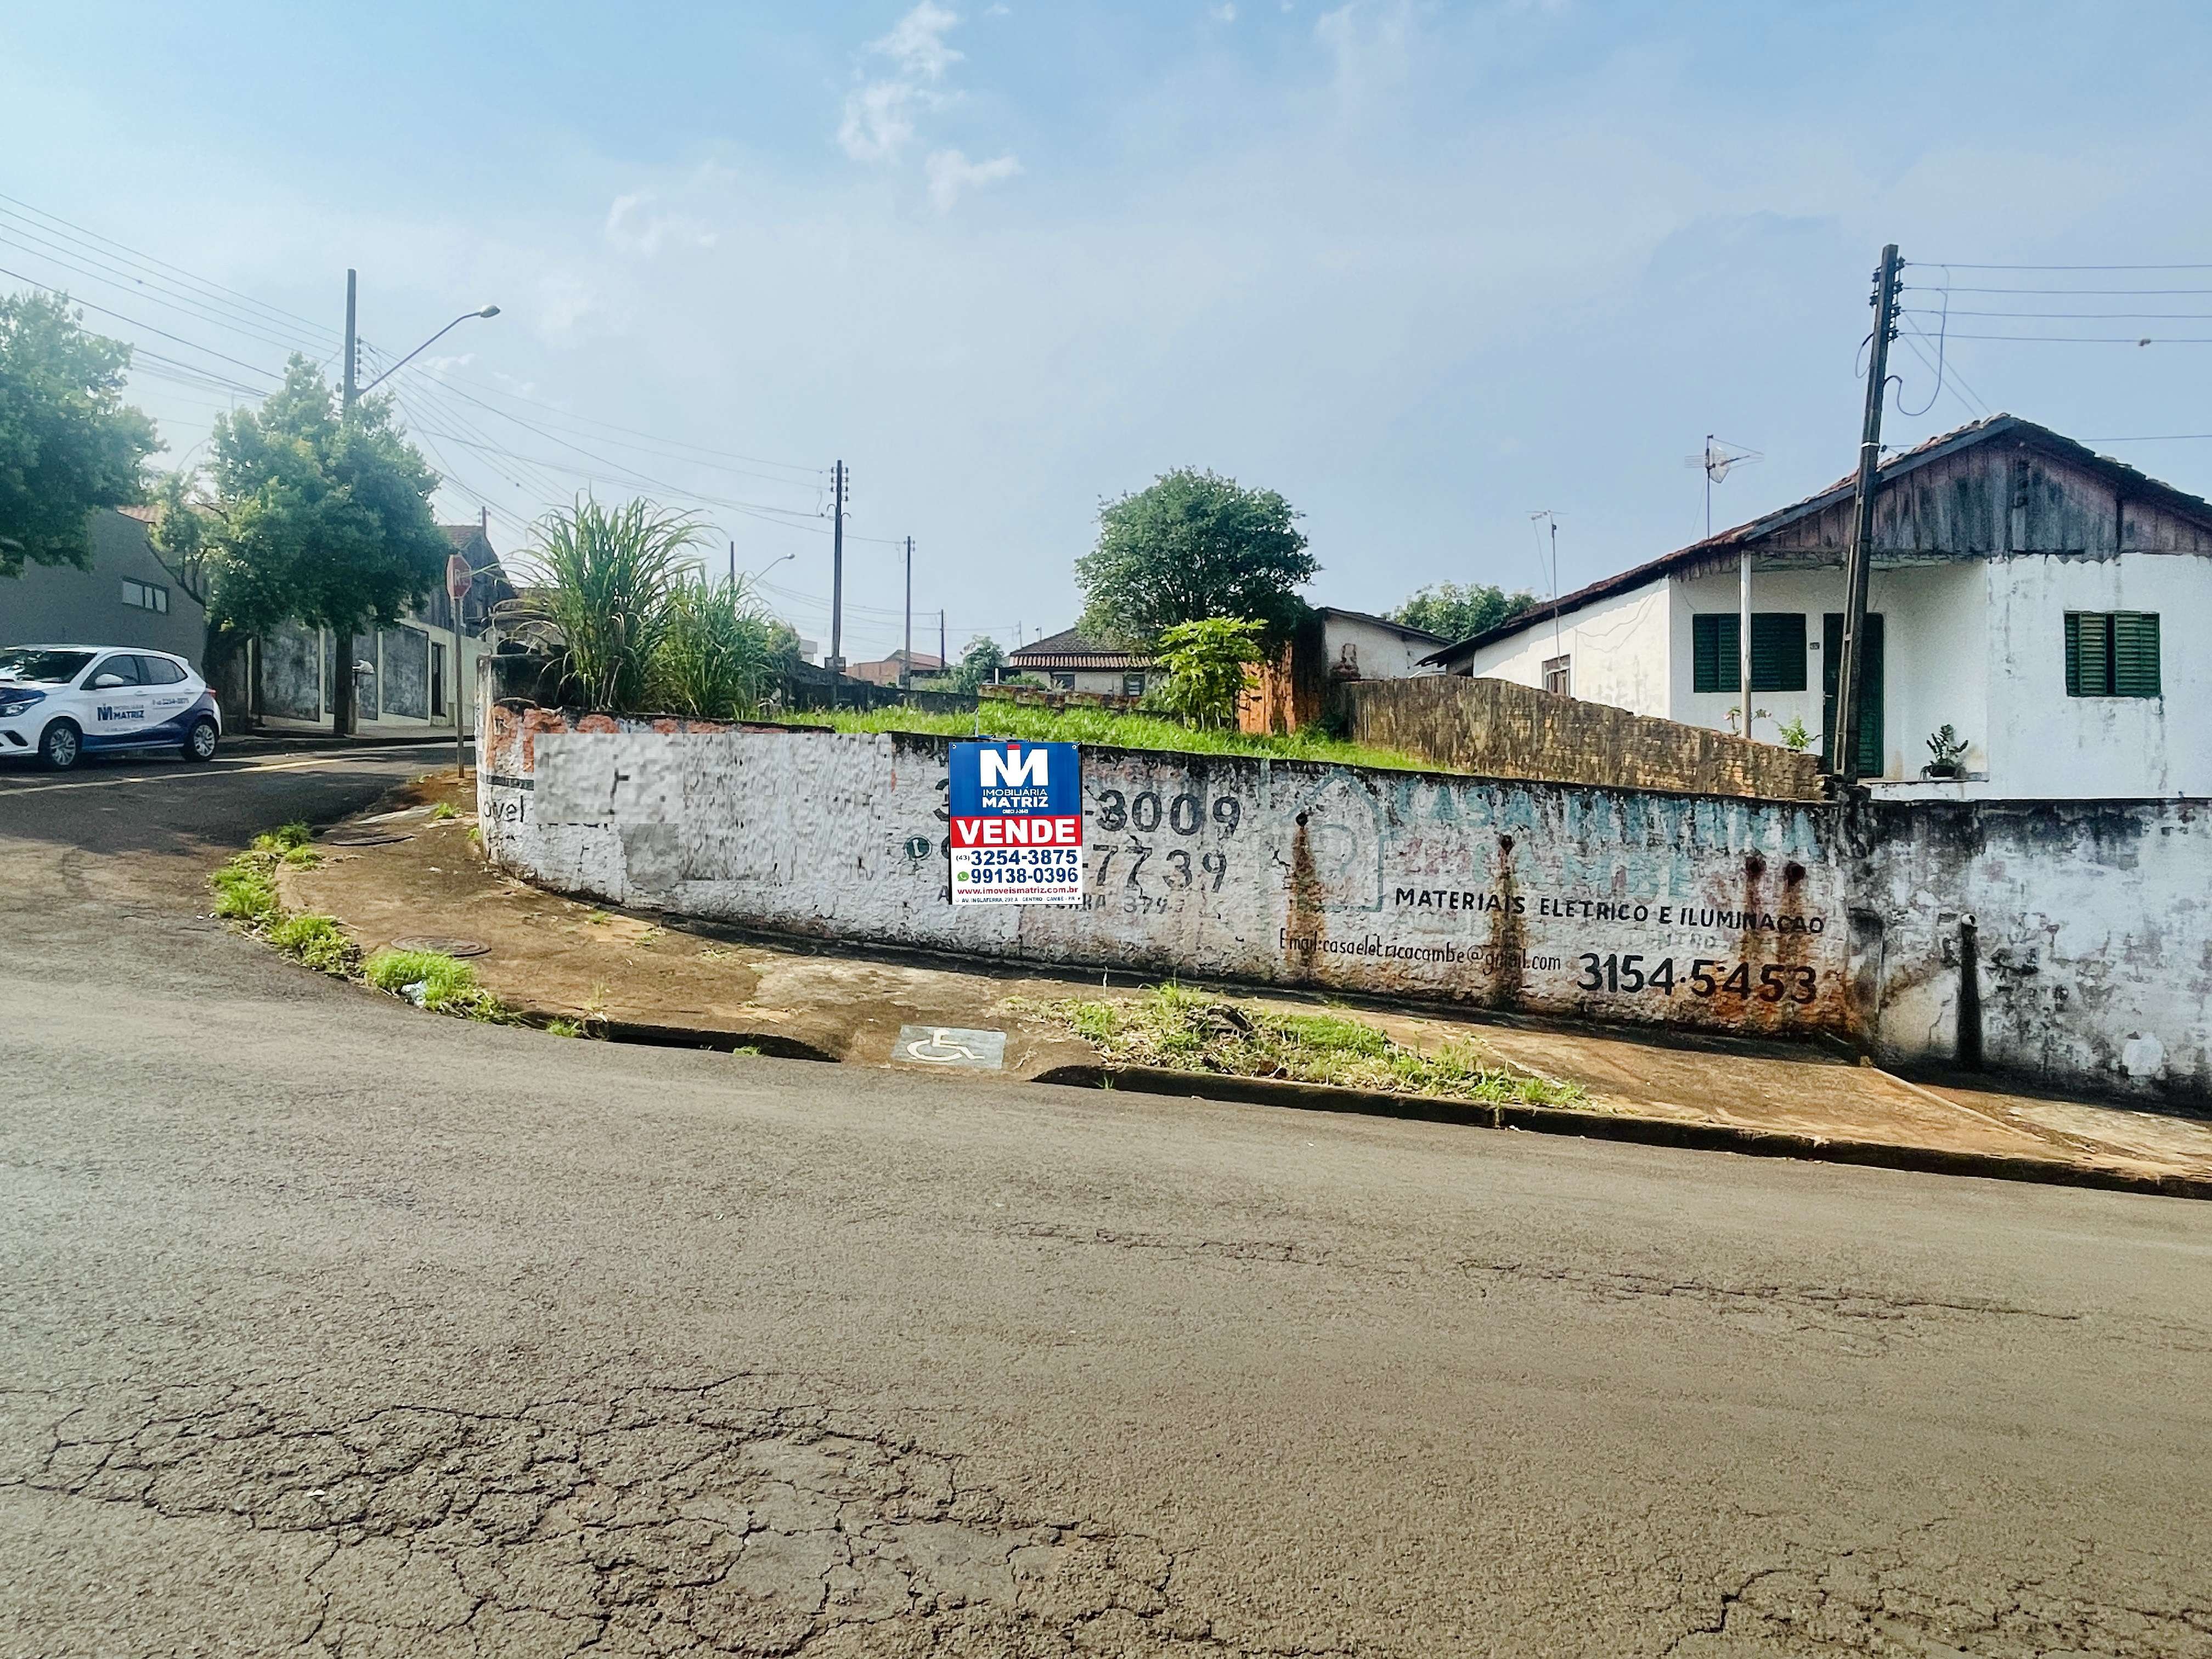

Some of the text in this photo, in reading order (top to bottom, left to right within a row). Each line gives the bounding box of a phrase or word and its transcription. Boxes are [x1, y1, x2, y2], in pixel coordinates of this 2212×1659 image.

[983, 787, 1047, 796] IMOBILIÁRIA
[983, 797, 1048, 808] MATRIZ
[956, 819, 1076, 845] VENDE
[971, 849, 1078, 866] 3254-3875
[971, 867, 1078, 884] 99138-0396
[957, 886, 1079, 894] www.imoveismatriz.com.br
[1541, 898, 1649, 922] ELETRICO
[1660, 906, 1672, 924] E
